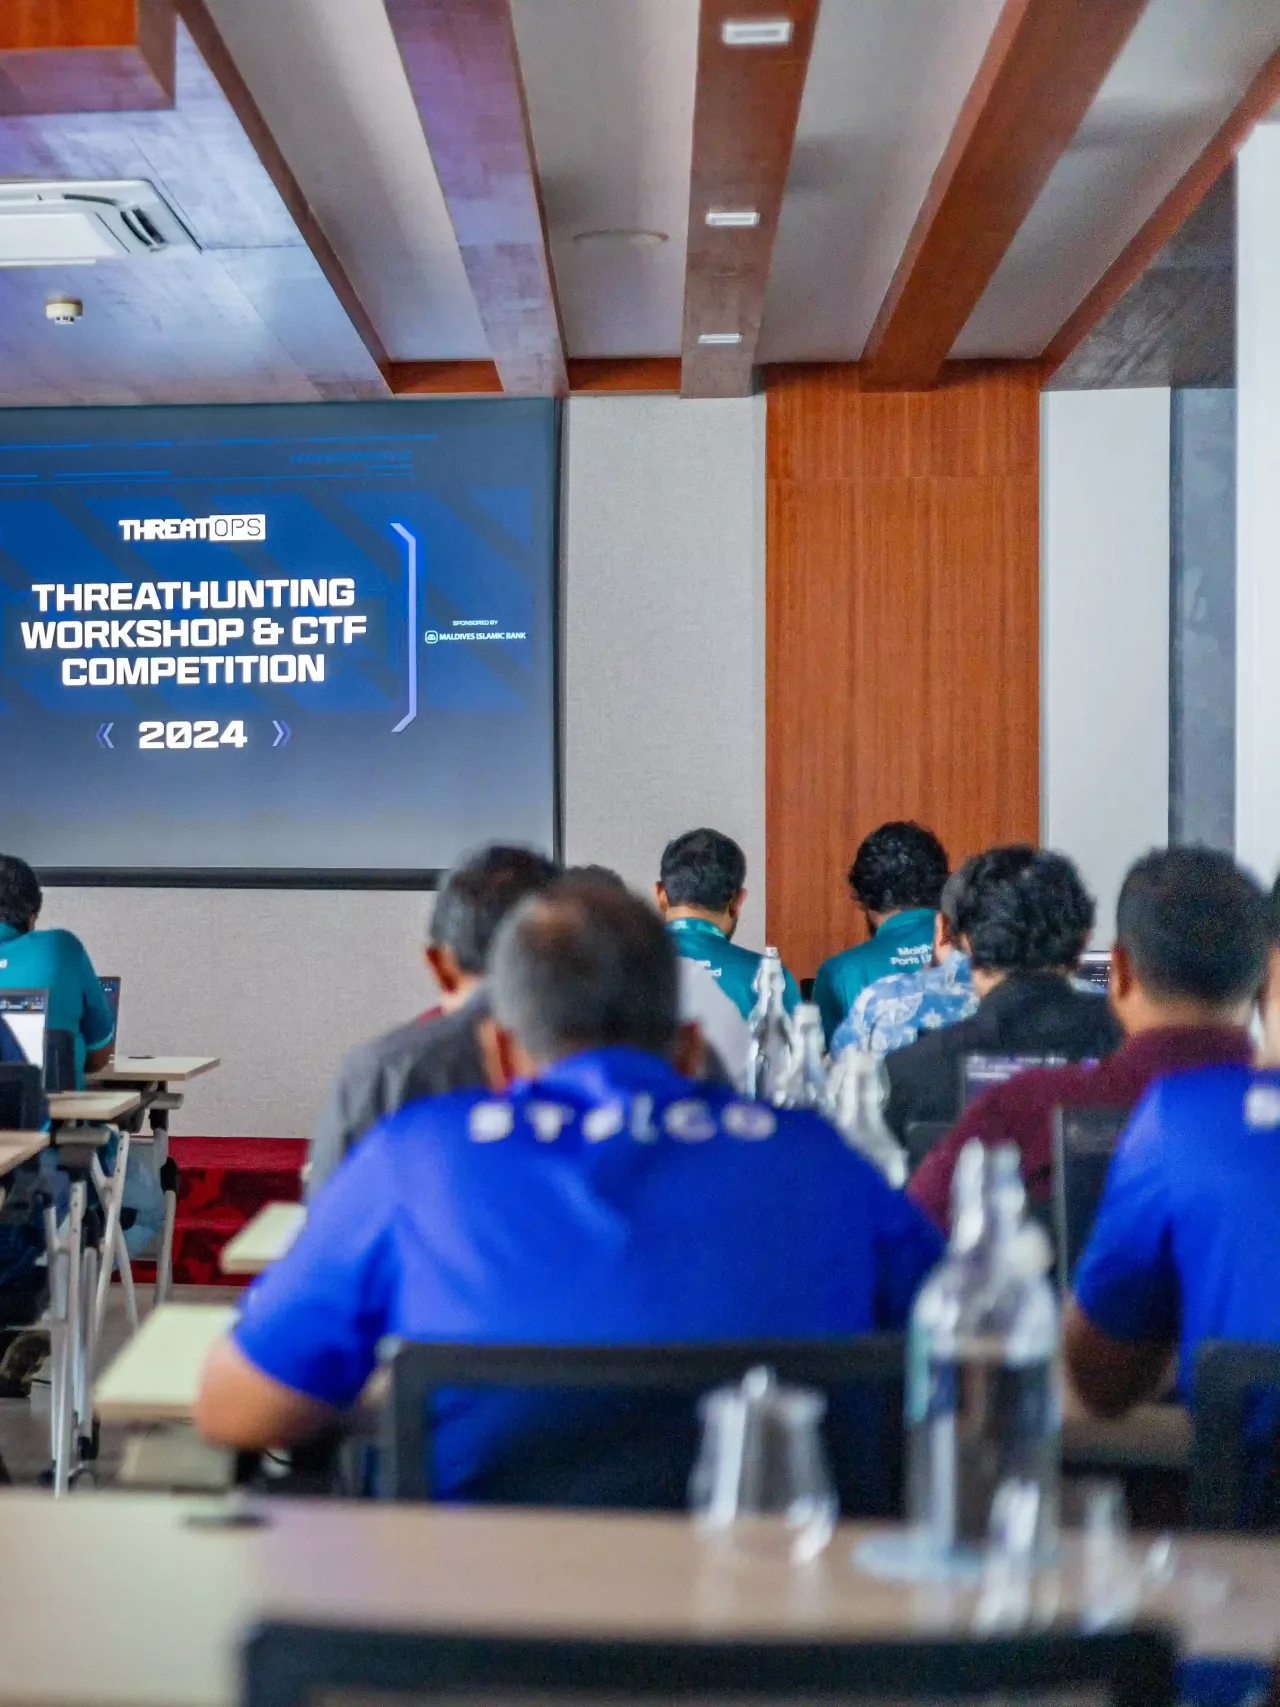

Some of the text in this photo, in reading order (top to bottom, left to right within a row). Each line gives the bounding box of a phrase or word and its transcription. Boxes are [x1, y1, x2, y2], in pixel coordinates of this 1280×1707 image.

[32, 578, 355, 611] THREATHUNTING
[21, 616, 367, 649] WORKSHOP & CTF
[476, 632, 505, 640] ISLAMIC
[505, 631, 526, 640] BANK
[62, 654, 325, 686] COMPETITION
[139, 720, 248, 749] 2024
